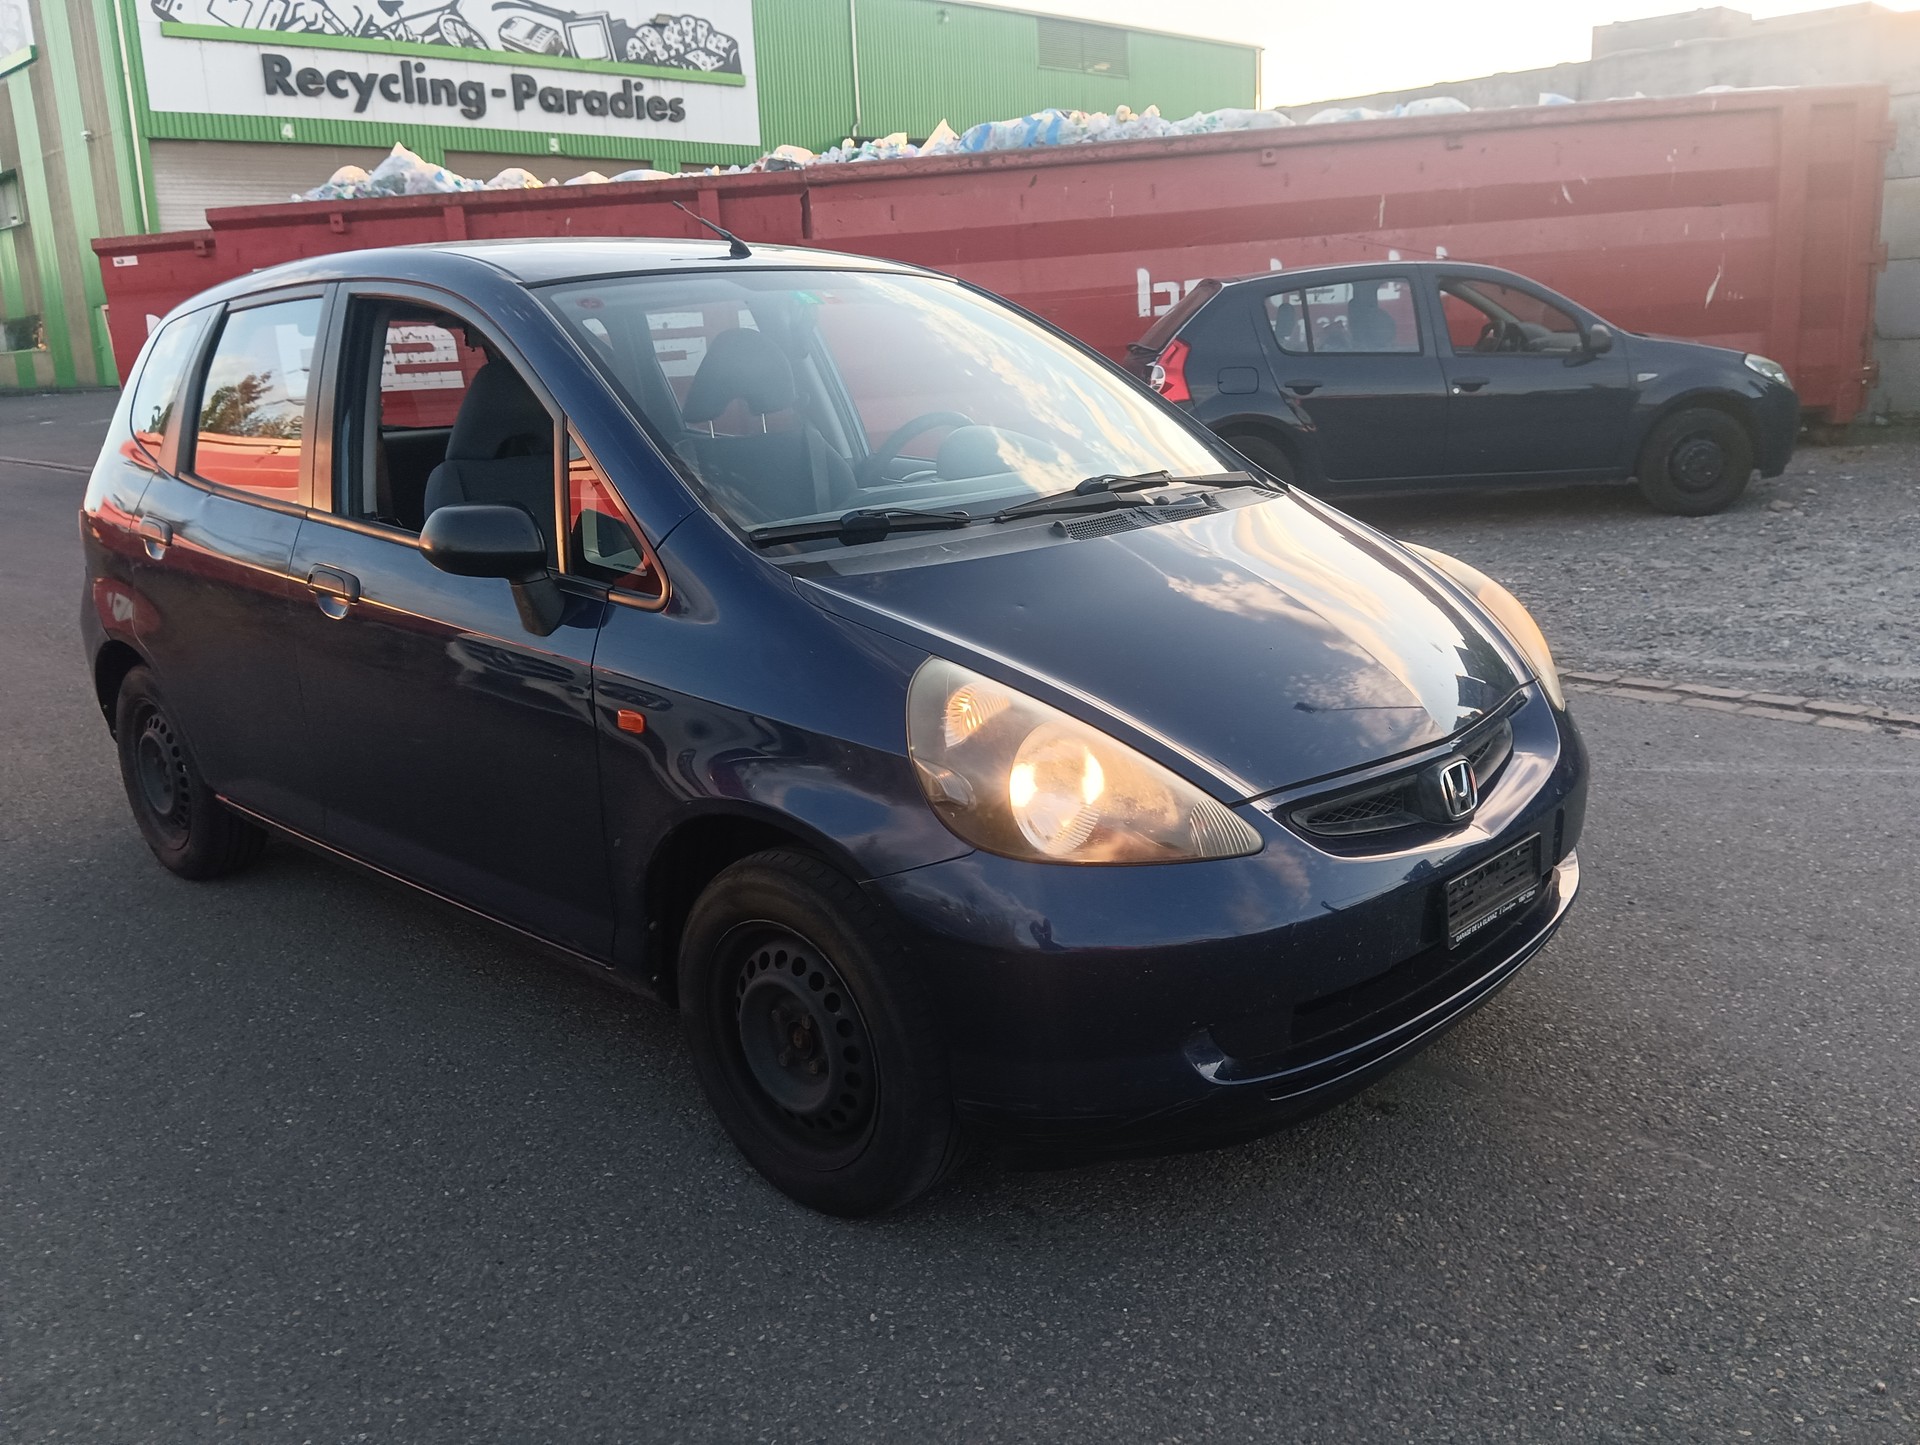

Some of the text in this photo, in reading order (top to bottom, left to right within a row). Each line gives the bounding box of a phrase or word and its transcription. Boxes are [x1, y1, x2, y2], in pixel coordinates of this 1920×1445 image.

[261, 53, 686, 123] Recycling-Paradies
[281, 123, 296, 139] 4
[549, 137, 560, 152] 5
